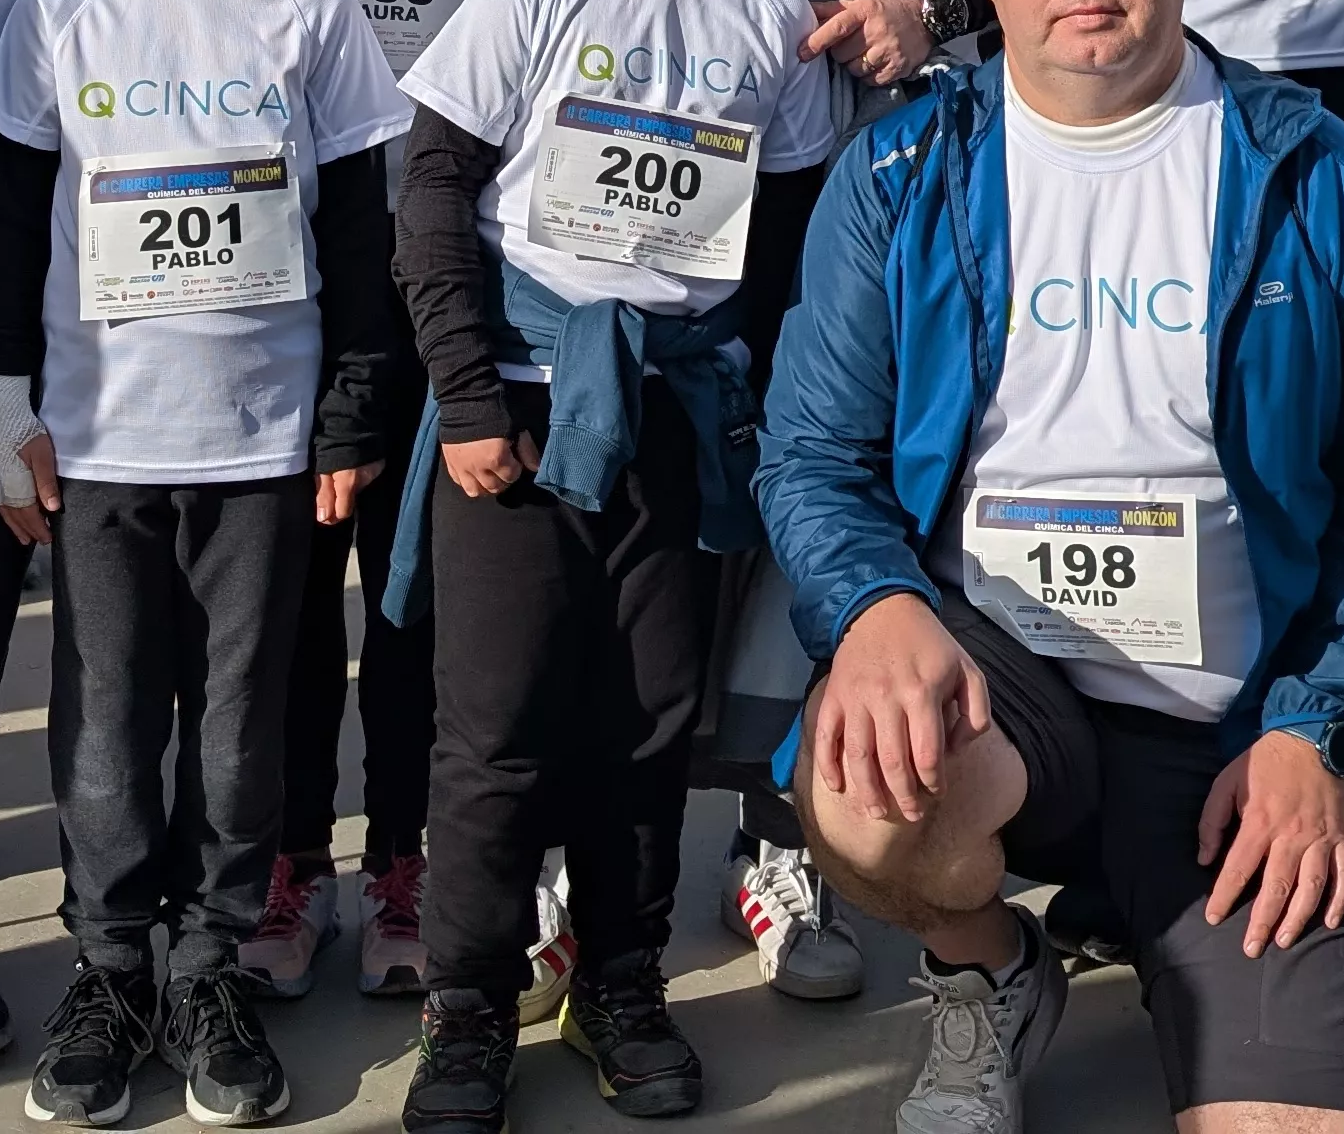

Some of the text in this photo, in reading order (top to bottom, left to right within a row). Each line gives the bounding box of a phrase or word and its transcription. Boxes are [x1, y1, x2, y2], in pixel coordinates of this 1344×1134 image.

[613, 128, 696, 151] QUÍMICA DEL CINCA
[695, 129, 744, 152] MONZÓN
[233, 161, 281, 184] MONZÓN
[595, 145, 701, 201] 200
[147, 185, 236, 199] QUÍMICA DEL CINCA
[604, 188, 681, 217] PABLO
[139, 202, 242, 252] 201
[152, 247, 234, 270] PABLO
[1254, 292, 1294, 307] Kalenji
[1034, 522, 1124, 534] QUÍMICA DEL CINCA
[1122, 507, 1177, 527] MONZÓN
[1027, 541, 1136, 589] 198
[1042, 587, 1118, 607] DAVID
